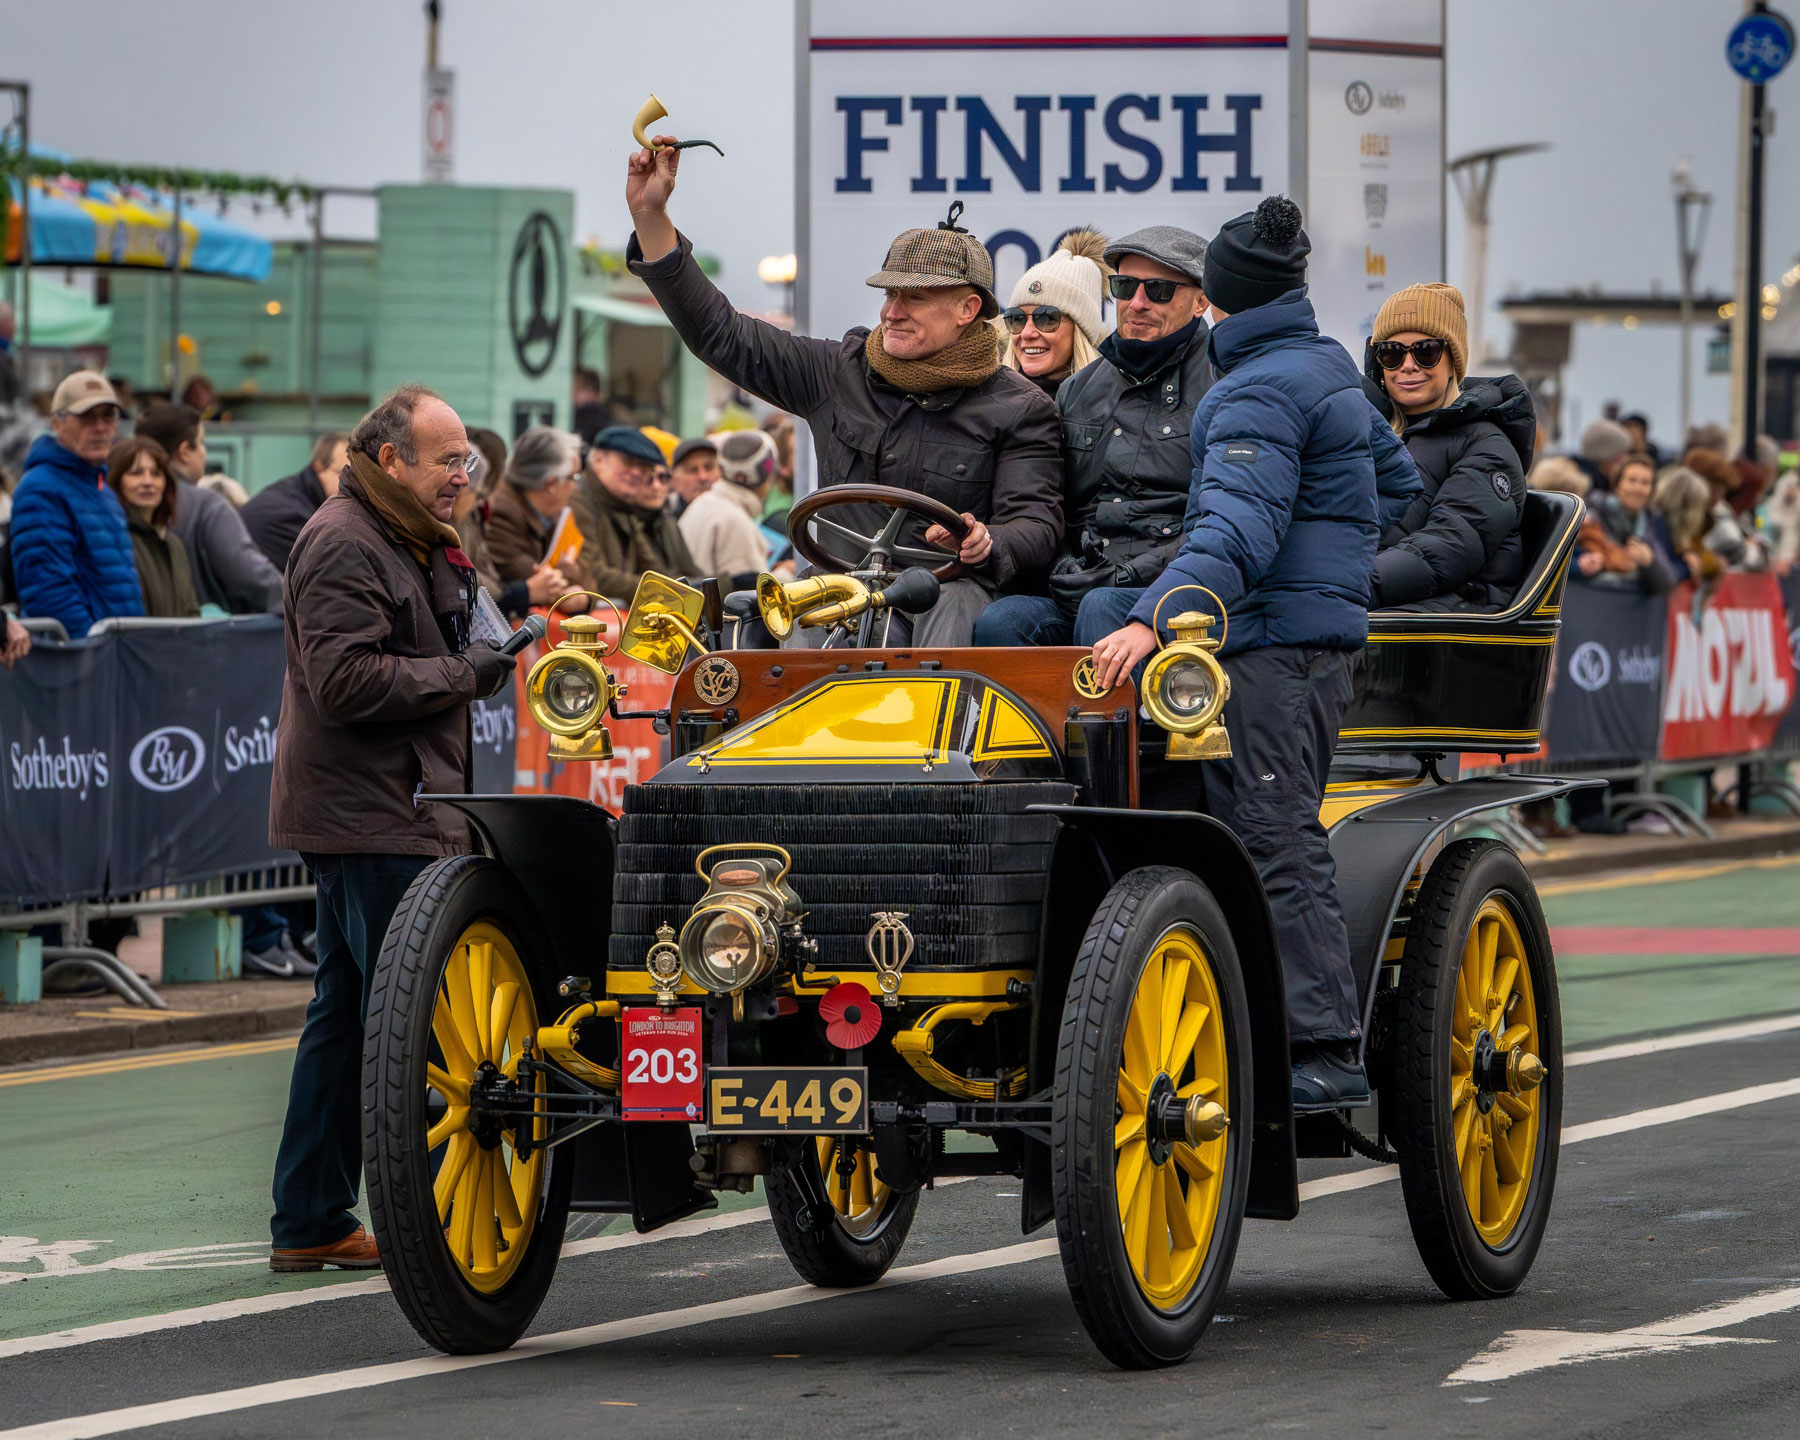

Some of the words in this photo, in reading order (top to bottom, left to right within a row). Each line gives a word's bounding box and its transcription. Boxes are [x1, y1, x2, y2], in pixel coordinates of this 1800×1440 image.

[834, 93, 1262, 193] FINISH
[1664, 607, 1788, 722] MOTUL
[11, 736, 109, 800] Sotheby's
[628, 1020, 654, 1033] LONDON
[655, 1020, 663, 1030] TO
[664, 1020, 695, 1033] BRIGHTON
[627, 1047, 699, 1084] 203
[711, 1077, 862, 1125] E-449
